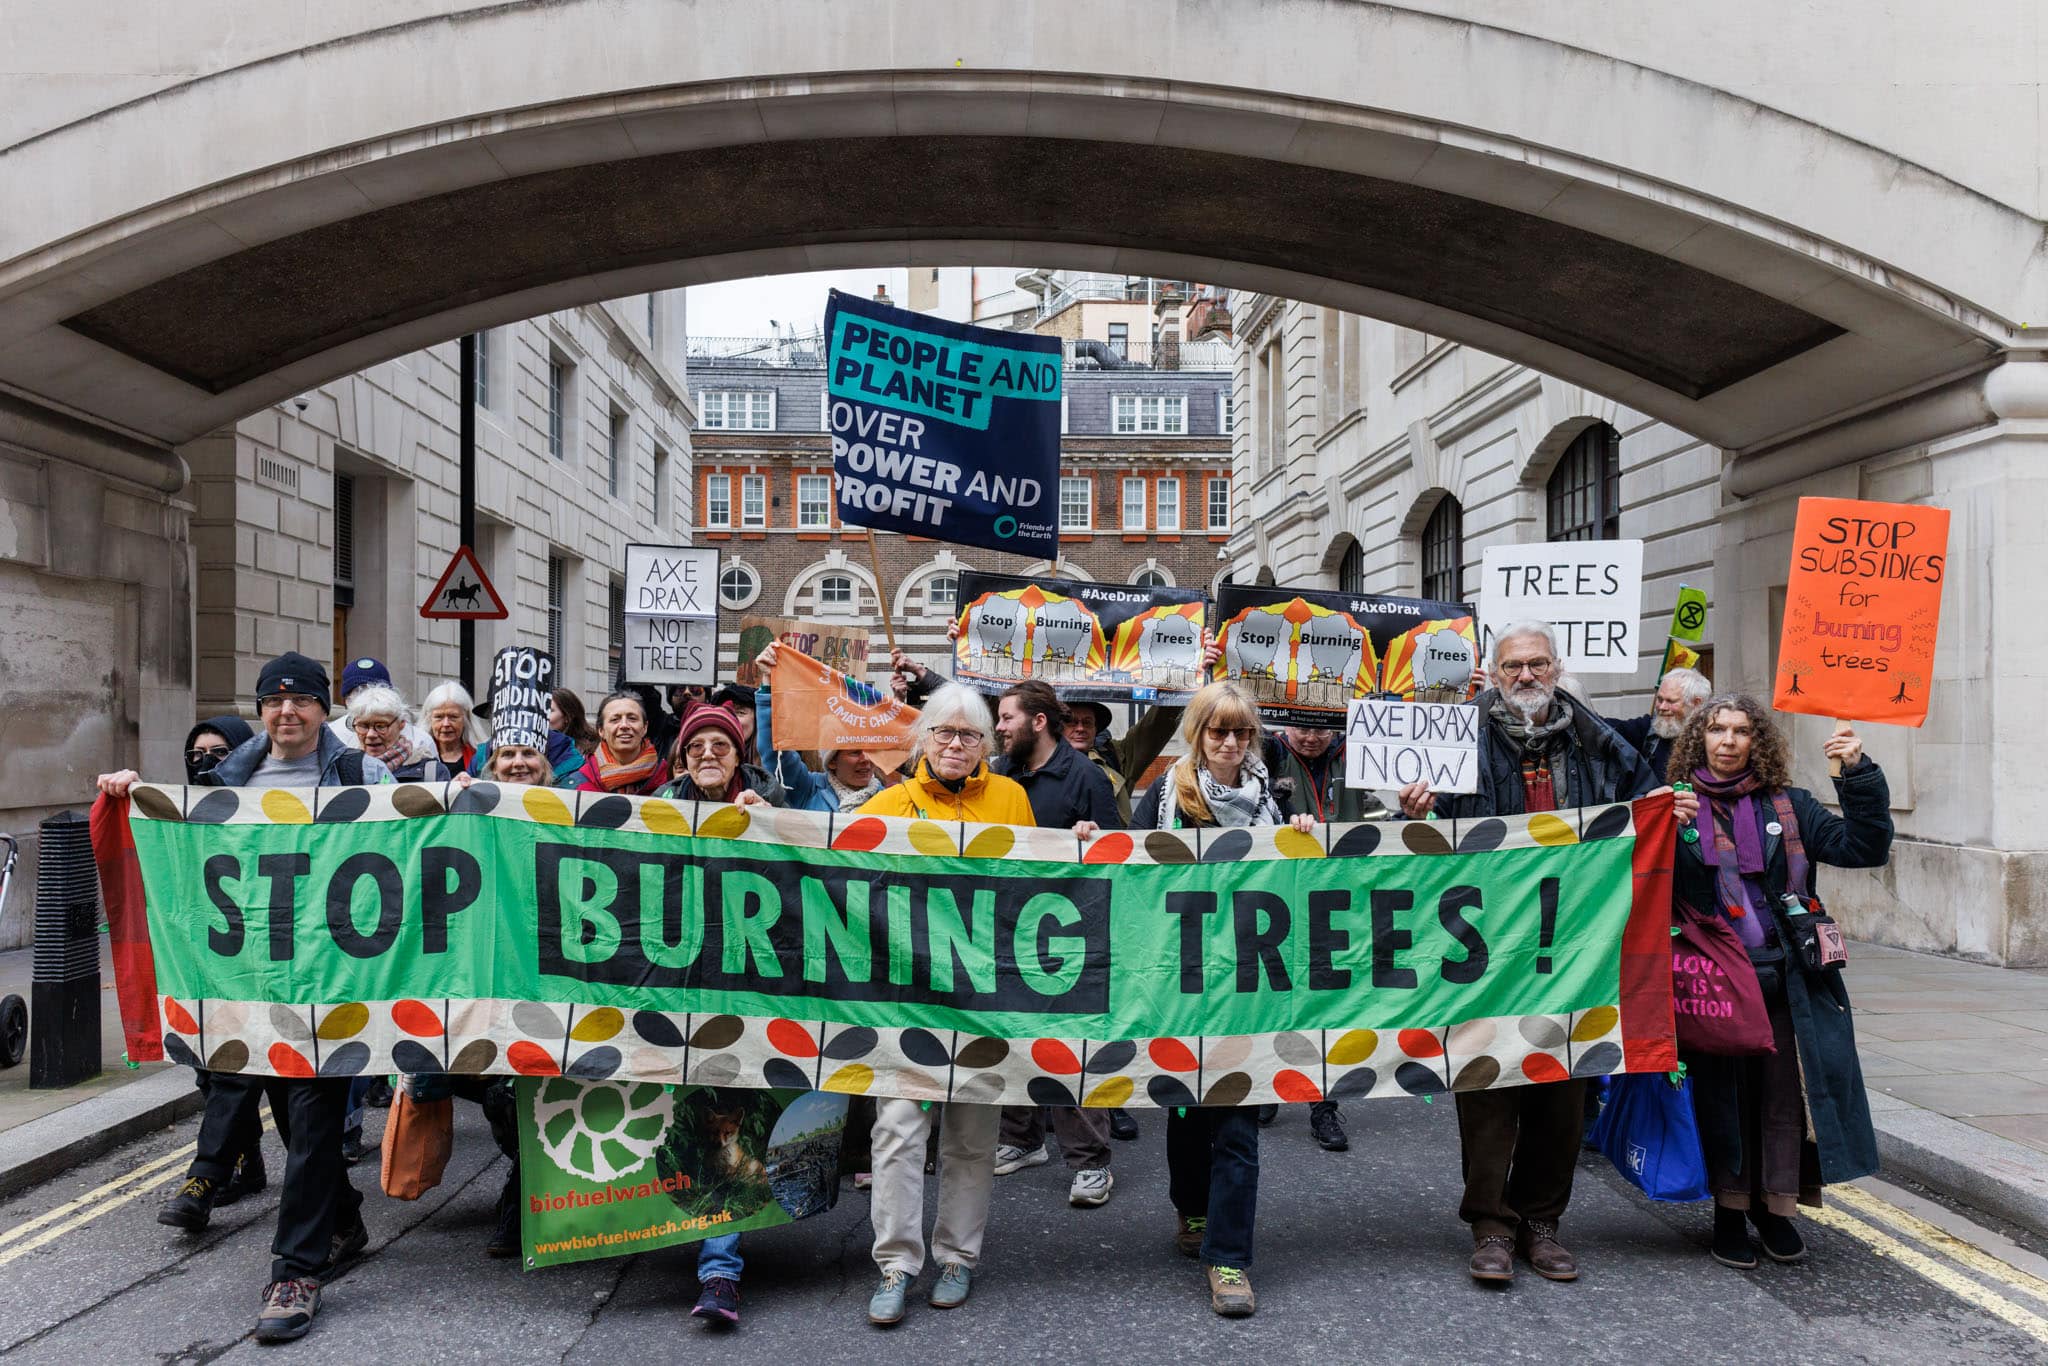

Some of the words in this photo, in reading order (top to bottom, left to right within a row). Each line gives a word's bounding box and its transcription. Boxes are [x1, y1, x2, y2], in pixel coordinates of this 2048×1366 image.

[842, 321, 983, 385] PEOPLE
[988, 358, 1057, 394] AND
[834, 356, 982, 420] PLANET
[831, 401, 925, 450] OVER
[832, 435, 962, 494] POWER
[964, 470, 1042, 508] AND
[1018, 522, 1045, 532] Friends
[1045, 524, 1053, 532] of
[1018, 530, 1030, 538] the
[1031, 531, 1052, 540] Earth
[1819, 517, 1916, 549] STOP
[646, 558, 698, 583] AXE
[1800, 547, 1943, 583] SUBSIDIES
[1497, 564, 1619, 597] TREES
[1839, 581, 1879, 607] for
[639, 586, 701, 611] DRAX
[1081, 588, 1151, 603] #AxeDrax
[1350, 600, 1421, 616] #AxeDrax
[649, 618, 695, 643] NOT
[981, 614, 1013, 628] Stop
[1036, 616, 1091, 634] Burning
[1156, 631, 1193, 645] Trees
[1812, 611, 1902, 653] burning
[781, 631, 819, 656] STOP
[1240, 632, 1275, 648] Stop
[1301, 633, 1361, 651] Burning
[1482, 621, 1628, 657] MTER
[495, 648, 552, 687] STOP
[634, 646, 703, 672] TREES
[1429, 648, 1468, 662] Trees
[1820, 645, 1890, 673] trees
[957, 676, 1014, 690] biofuelwatch.or
[493, 685, 553, 719] FUNDING
[826, 696, 867, 728] CLIMATE
[491, 710, 550, 739] POLLUTION
[1350, 703, 1406, 738] AXE
[1411, 705, 1476, 743] DRAX
[1360, 745, 1468, 787] NOW
[203, 845, 483, 962] STOP
[557, 856, 1087, 997] BURNING
[1692, 978, 1708, 996] IS
[530, 1170, 692, 1214] biofuelwatch
